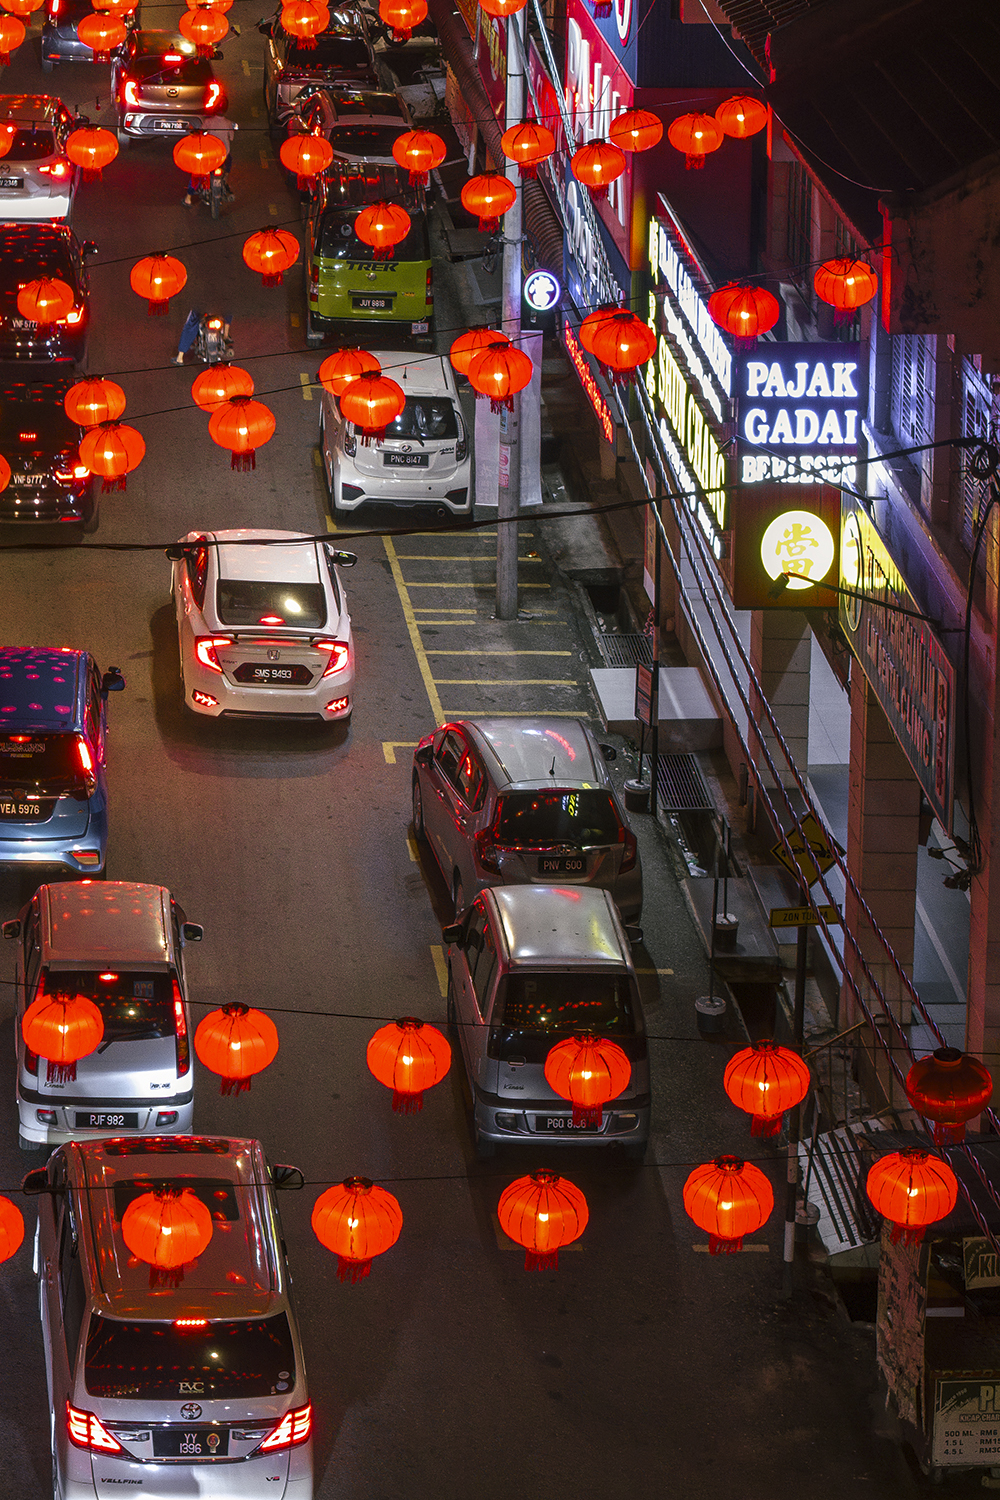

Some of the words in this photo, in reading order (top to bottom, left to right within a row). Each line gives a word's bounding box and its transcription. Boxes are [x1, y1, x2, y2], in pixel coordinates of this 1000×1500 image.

[346, 261, 400, 272] TREK
[746, 361, 859, 399] PAJAK
[744, 408, 858, 445] GADAI
[658, 334, 687, 447] SHUN
[686, 393, 726, 531] CHANG
[390, 454, 405, 463] PNC
[405, 455, 422, 464] 8147
[741, 454, 858, 485] BERLESEN
[254, 668, 270, 679] SMS
[271, 669, 292, 679] 9493
[900, 684, 930, 768] CLINIC
[0, 803, 16, 815] VEA
[18, 803, 40, 815] 5976
[543, 860, 561, 871] PNV
[565, 860, 583, 871] 500
[783, 913, 800, 922] ZON
[89, 1114, 106, 1126] PJF
[106, 1114, 125, 1126] 982
[178, 1381, 205, 1391] PVC
[959, 1413, 982, 1422] KICAP
[184, 1433, 198, 1444] YY
[944, 1430, 961, 1438] 500
[961, 1430, 975, 1438] ML
[979, 1429, 999, 1437] RM6
[179, 1442, 202, 1455] 1396
[944, 1448, 958, 1456] 4.5
[100, 1477, 144, 1485] VELLFIRE
